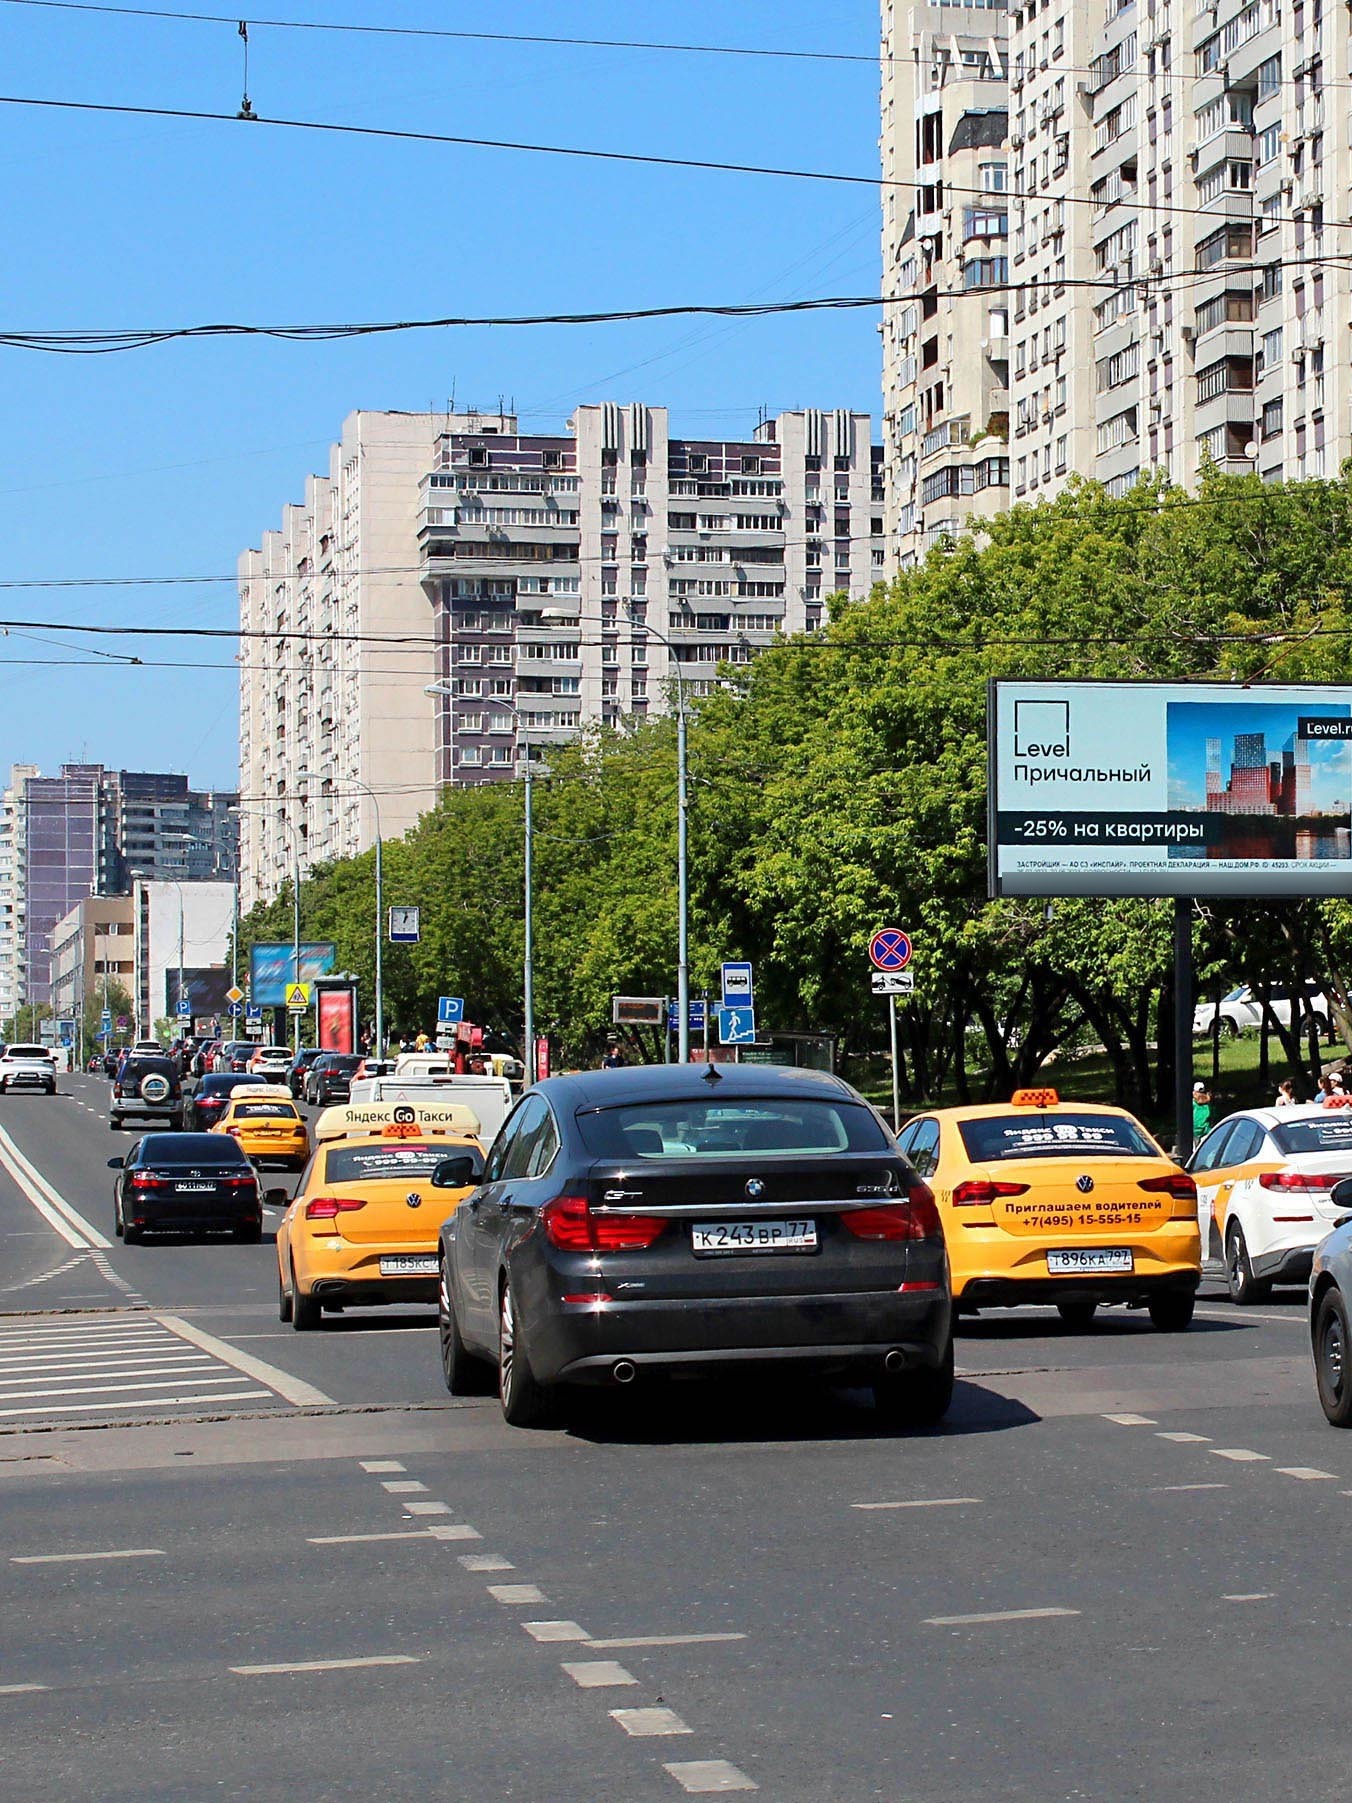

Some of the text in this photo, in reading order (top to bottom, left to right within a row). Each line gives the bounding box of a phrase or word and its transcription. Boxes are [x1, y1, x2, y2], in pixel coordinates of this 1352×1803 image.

[1014, 734, 1070, 757] Level
[1014, 763, 1151, 786] Причальный
[1014, 820, 1204, 842] -25% на квартиры
[346, 1109, 453, 1123] Яндекс Go Такси
[1005, 1200, 1162, 1215] Приглашаем водителей
[1023, 1213, 1141, 1228] +7(495) 15-555-15
